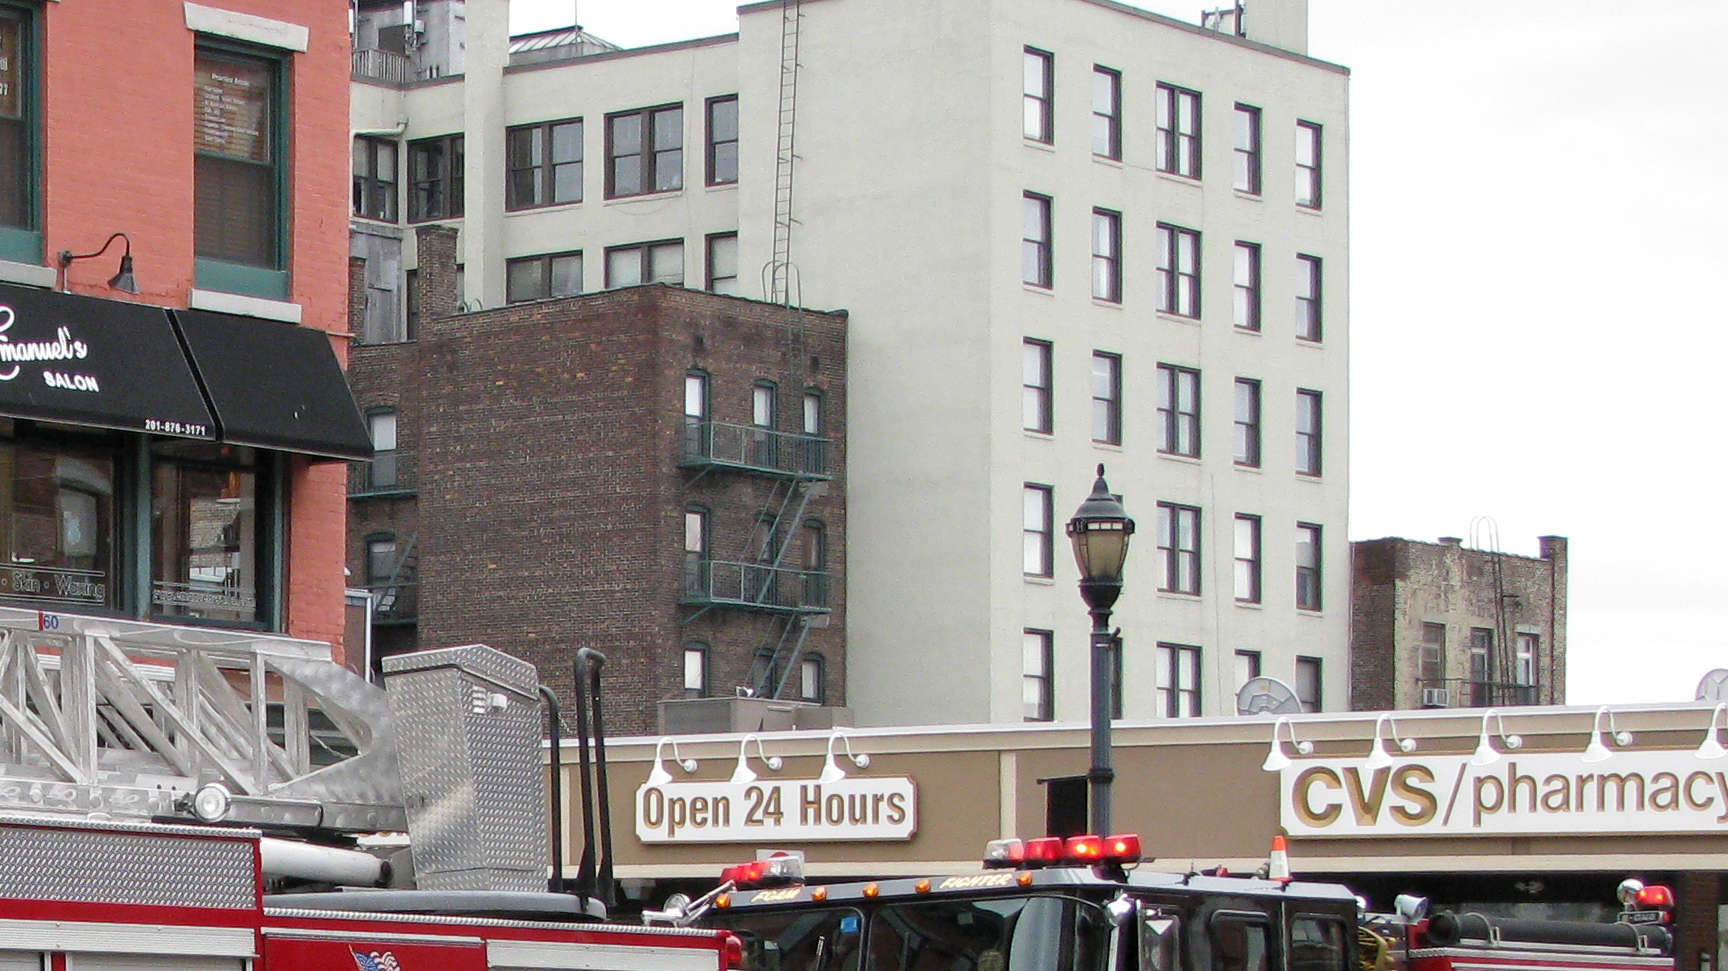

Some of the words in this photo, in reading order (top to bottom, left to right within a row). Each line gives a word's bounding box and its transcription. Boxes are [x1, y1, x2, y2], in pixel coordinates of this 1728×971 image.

[43, 371, 100, 393] SALON
[12, 571, 41, 593] Skin
[54, 573, 106, 602] Waxing
[43, 615, 59, 629] 60
[642, 786, 730, 838] Open
[743, 785, 784, 827] 24
[799, 783, 906, 826] Hours
[751, 888, 802, 903] FOAM
[938, 873, 1014, 890] FIGHTER
